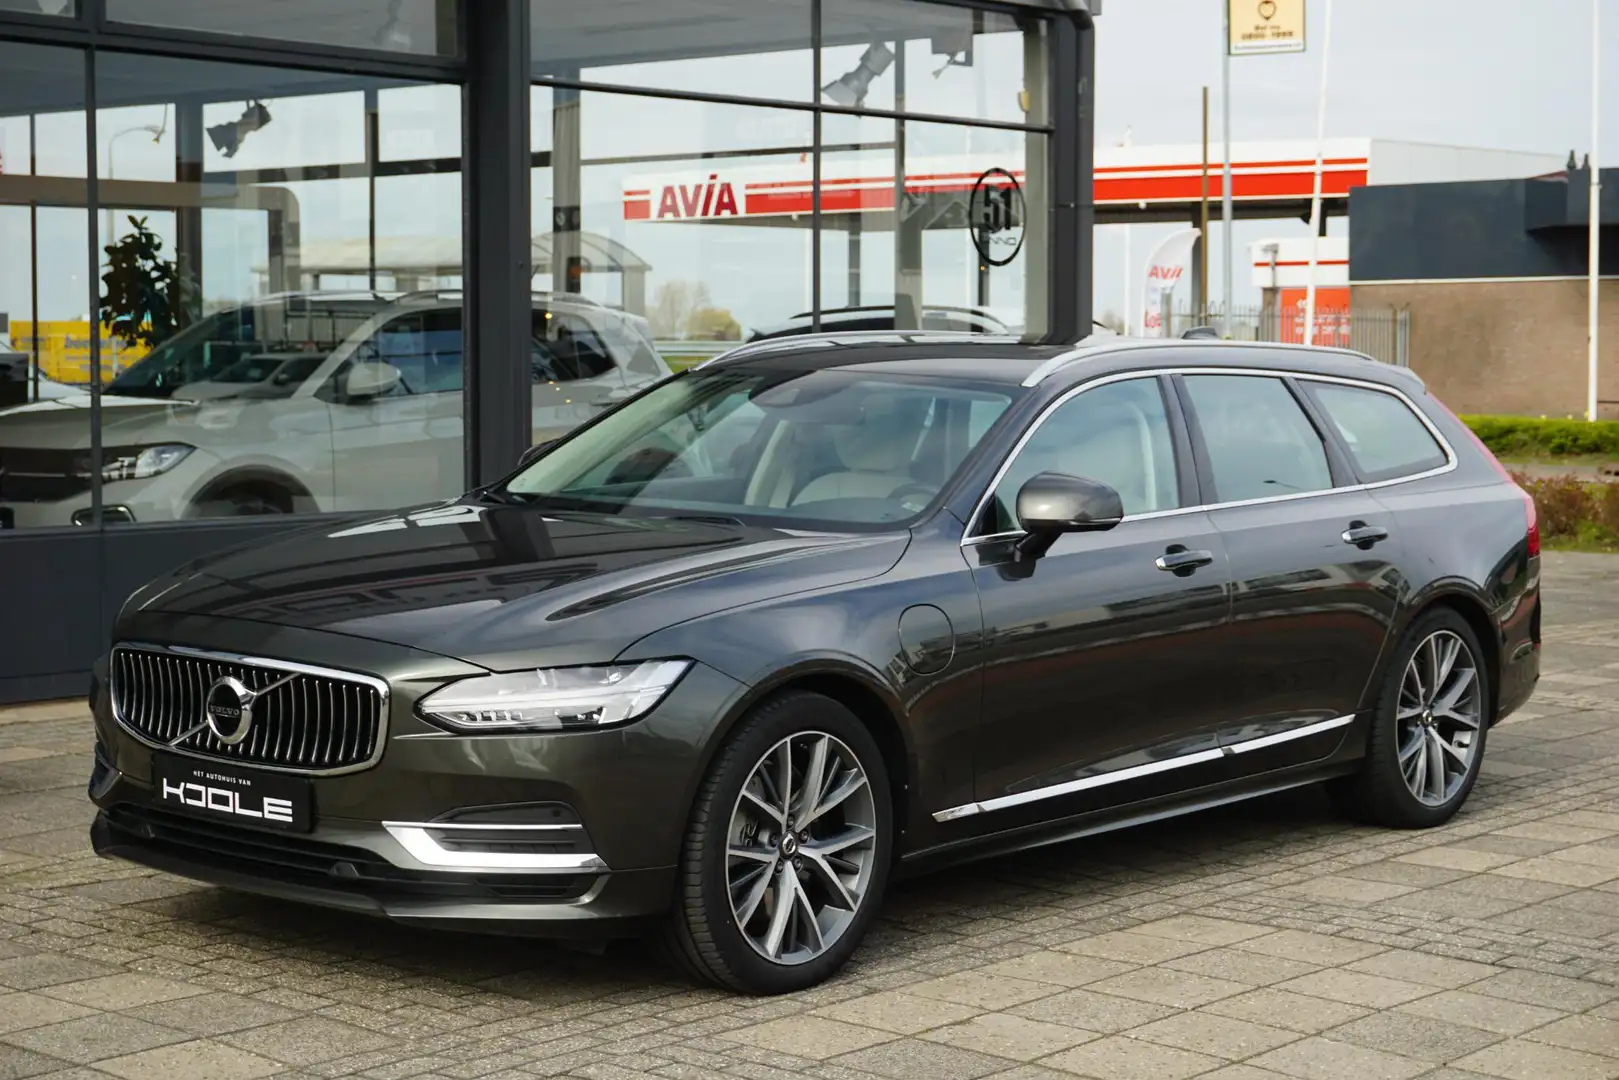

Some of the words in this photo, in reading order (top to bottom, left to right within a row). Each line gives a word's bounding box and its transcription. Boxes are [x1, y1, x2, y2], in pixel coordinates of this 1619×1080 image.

[657, 174, 739, 218] AVIA
[210, 705, 240, 715] VOLVO
[193, 770, 204, 778] HET
[206, 772, 237, 784] AUTOHUIS
[238, 778, 251, 787] VAN
[163, 777, 293, 822] KOOLE
